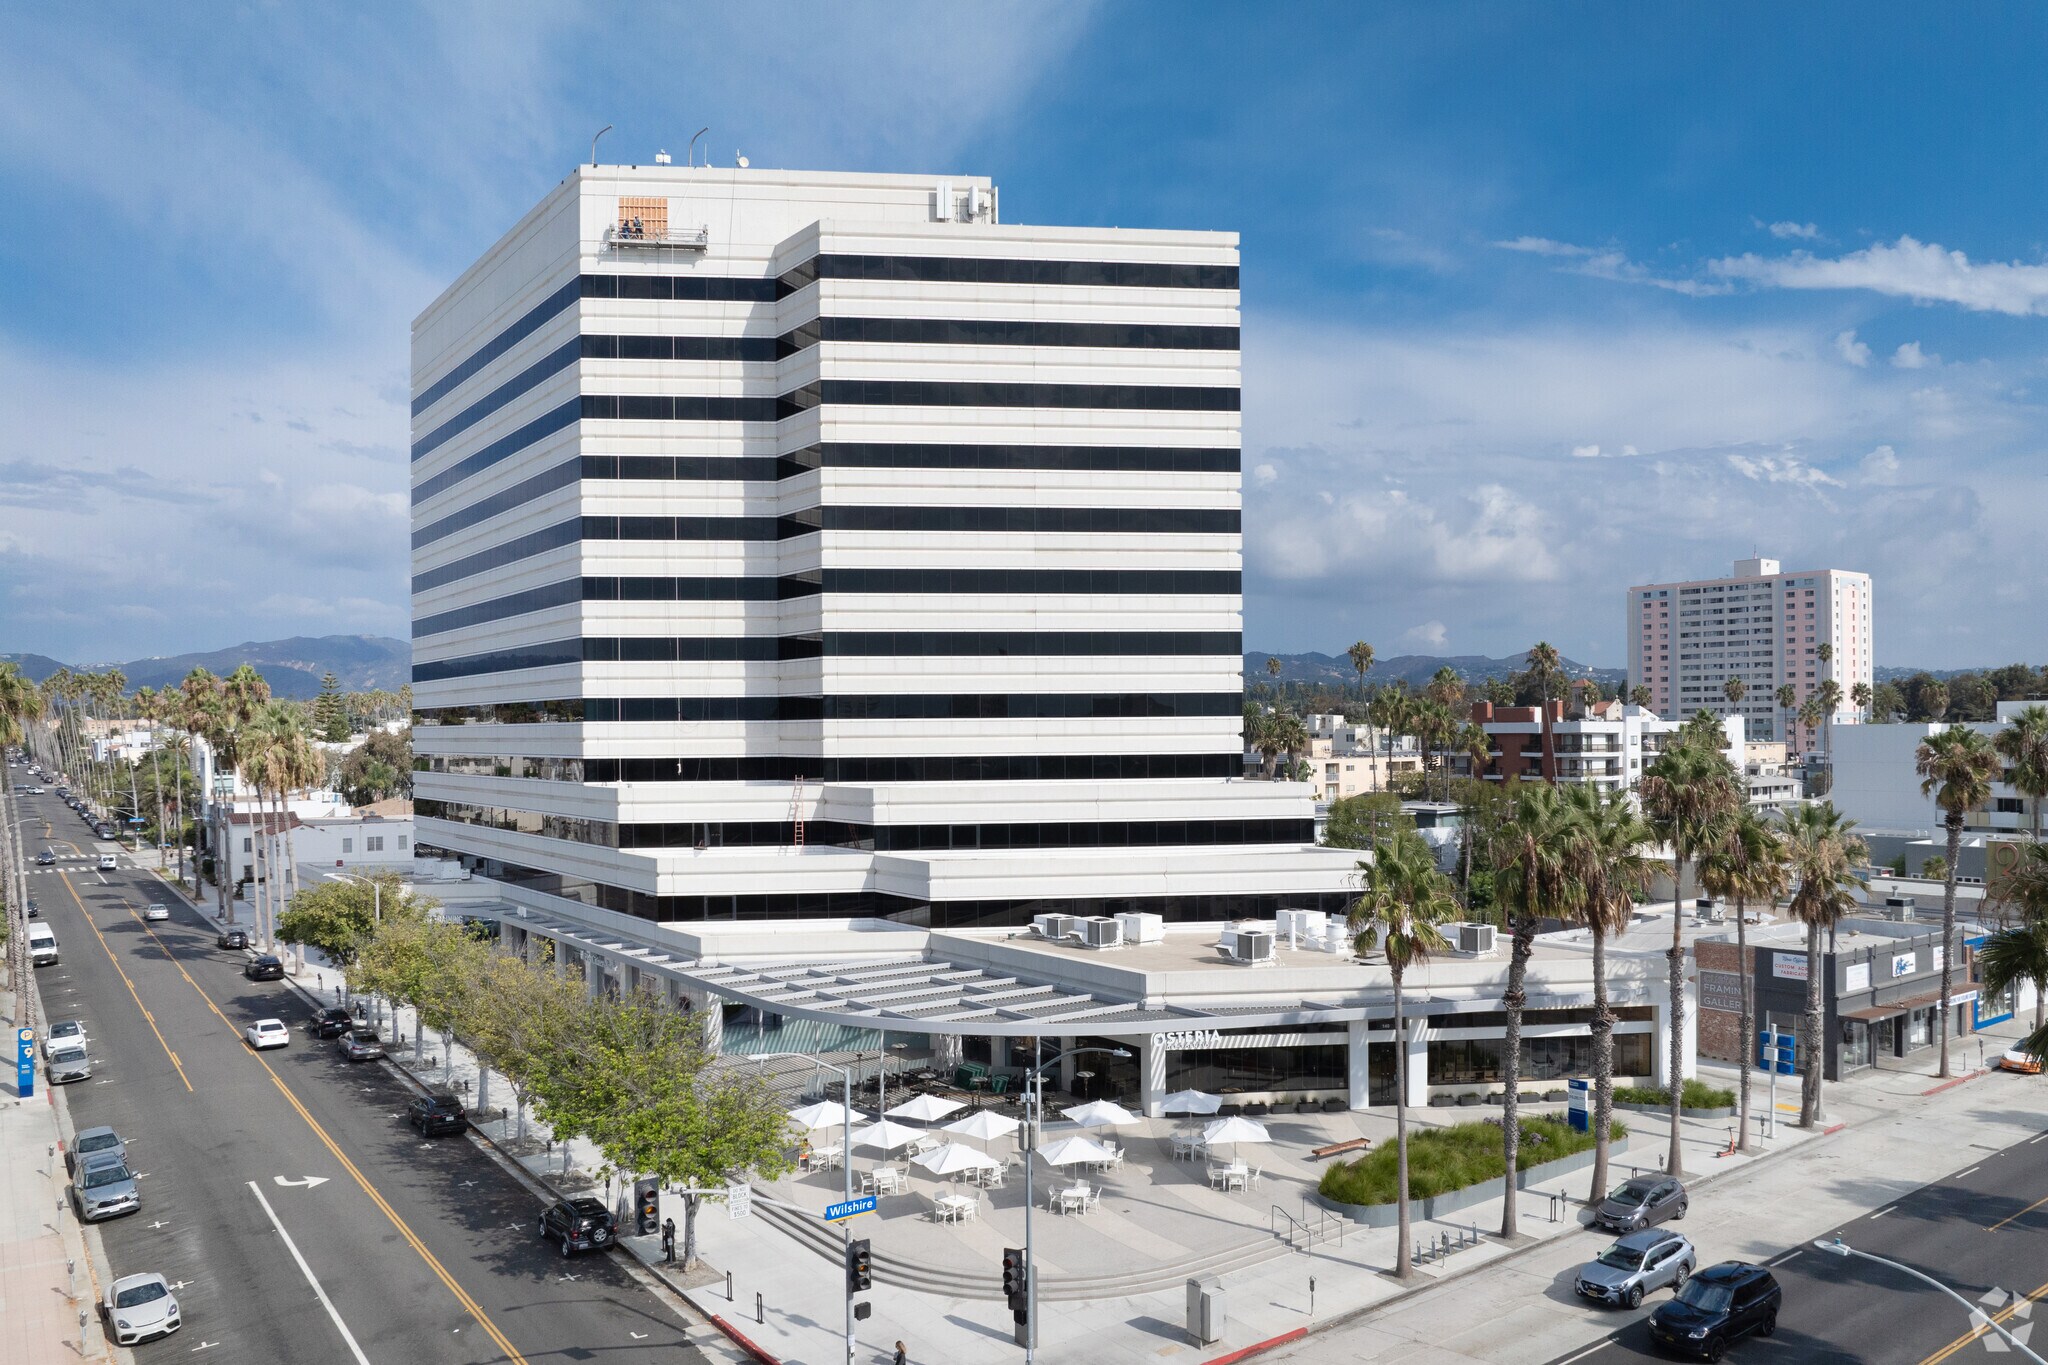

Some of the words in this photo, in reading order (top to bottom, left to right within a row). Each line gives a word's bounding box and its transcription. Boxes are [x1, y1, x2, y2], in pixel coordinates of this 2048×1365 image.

[1703, 983, 1742, 995] FRAMIN
[1703, 996, 1742, 1010] GALLER
[1154, 1029, 1221, 1047] OSTERIA
[24, 1047, 33, 1058] 9
[830, 1200, 873, 1217] Wilshire
